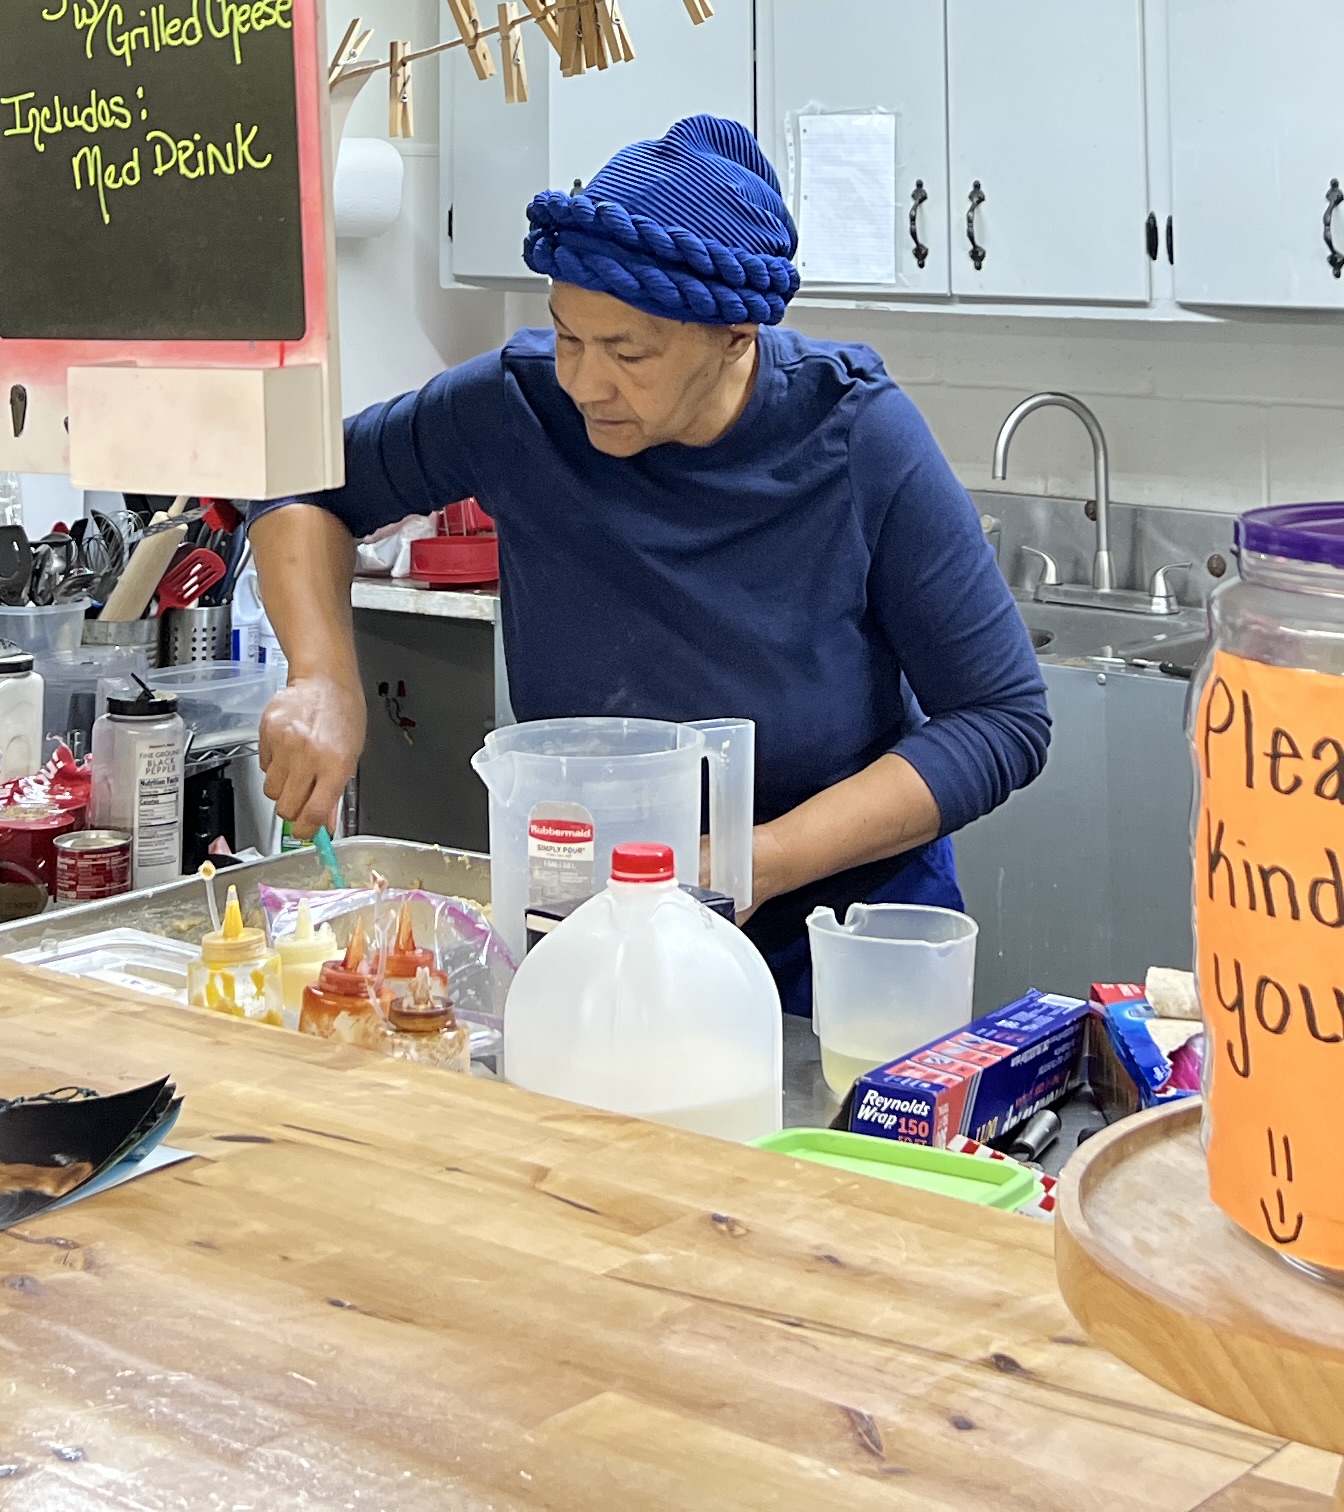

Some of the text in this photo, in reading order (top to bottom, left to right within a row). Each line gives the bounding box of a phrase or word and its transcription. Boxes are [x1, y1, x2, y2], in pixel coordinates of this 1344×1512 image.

[72, 146, 141, 225] Med
[530, 824, 591, 838] Rubbermaid
[862, 1089, 931, 1117] Reynolds
[857, 1104, 898, 1130] Wrap
[897, 1116, 929, 1138] 150
